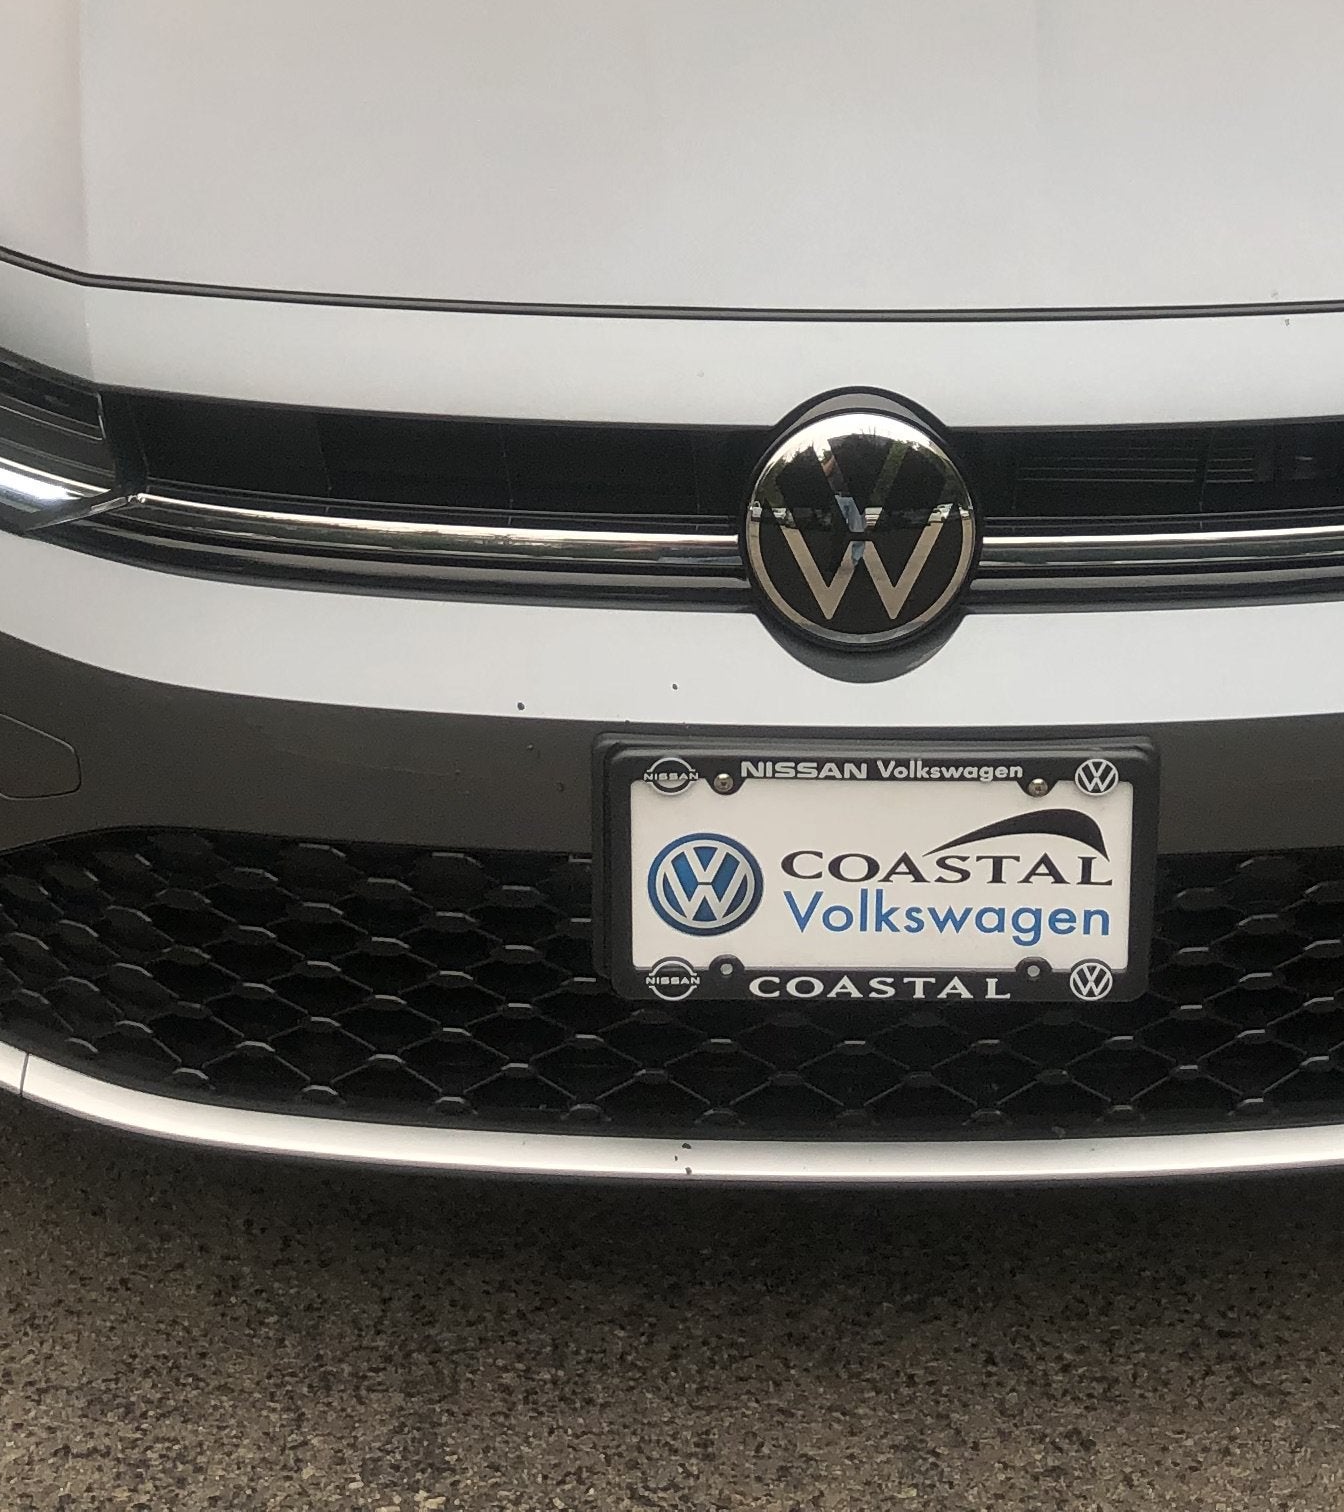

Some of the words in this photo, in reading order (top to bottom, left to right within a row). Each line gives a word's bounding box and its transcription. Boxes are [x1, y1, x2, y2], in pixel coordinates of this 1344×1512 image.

[754, 426, 968, 621] VW
[643, 772, 699, 782] NISSAN
[740, 760, 868, 780] NISSAN
[875, 759, 1024, 782] Volkswagen
[657, 841, 754, 927] VW
[780, 849, 1113, 887] COASTAL
[783, 889, 1111, 947] Volkswagen
[645, 976, 701, 985] NISSAN
[748, 974, 1012, 1000] COASTAL
